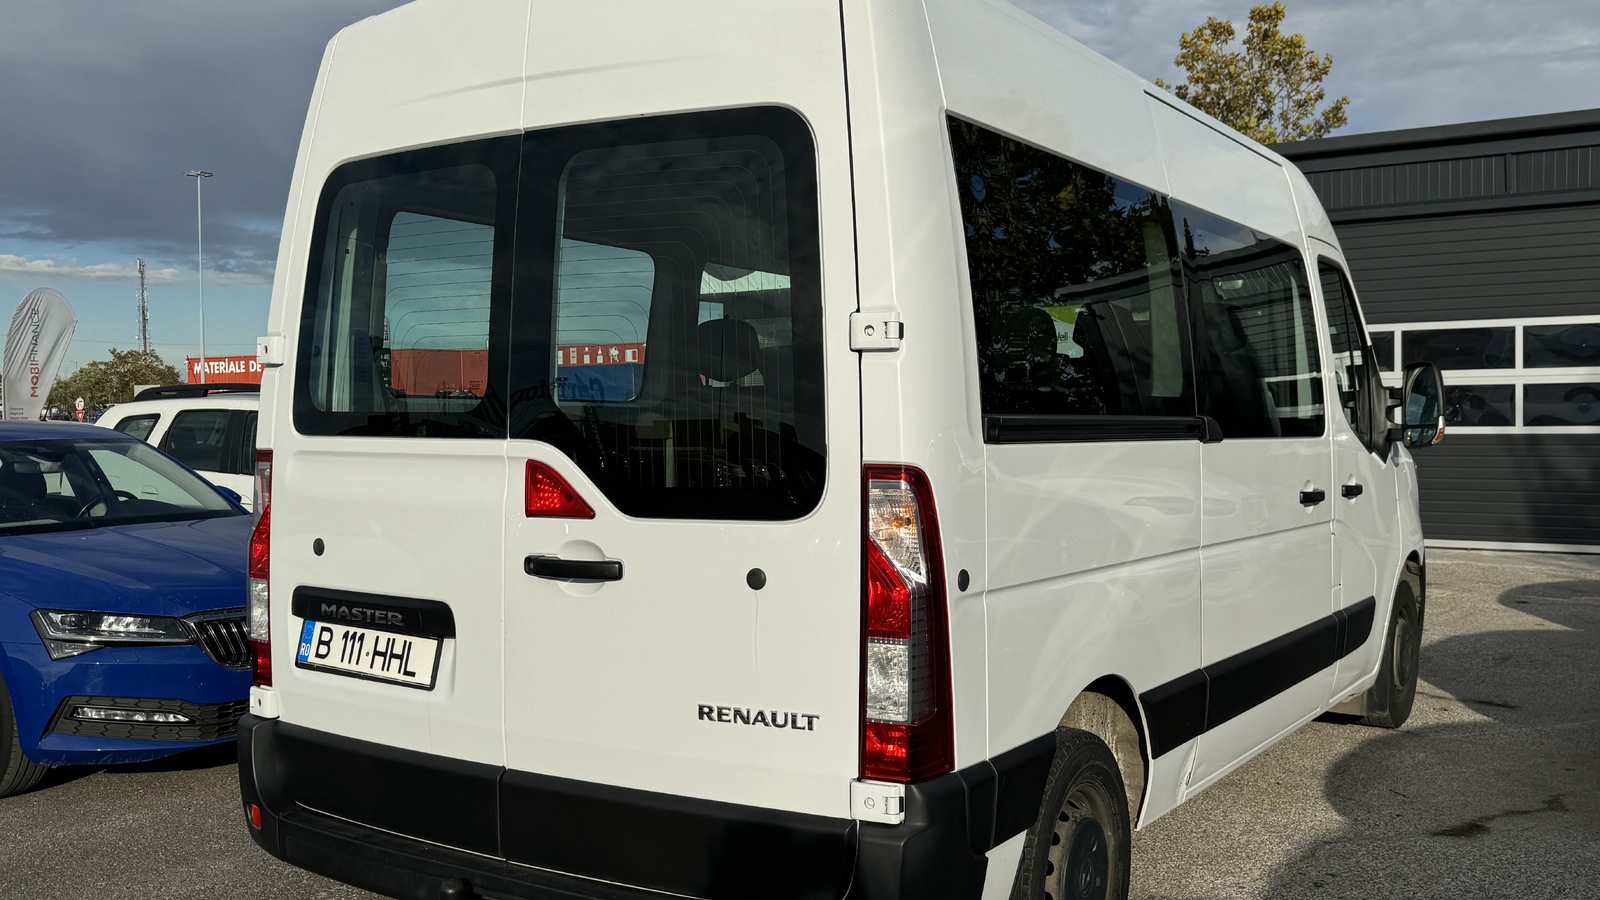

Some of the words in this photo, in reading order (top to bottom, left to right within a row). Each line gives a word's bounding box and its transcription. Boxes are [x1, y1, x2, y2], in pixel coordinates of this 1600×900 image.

[30, 308, 40, 398] MOBIFINANCE
[194, 359, 246, 375] MATERIALE
[249, 360, 262, 373] DE
[320, 603, 405, 626] MASTER
[300, 642, 311, 656] RO
[315, 626, 333, 659] B
[340, 630, 366, 665] 111
[370, 636, 416, 677] HHL
[697, 704, 820, 731] RENAULT
